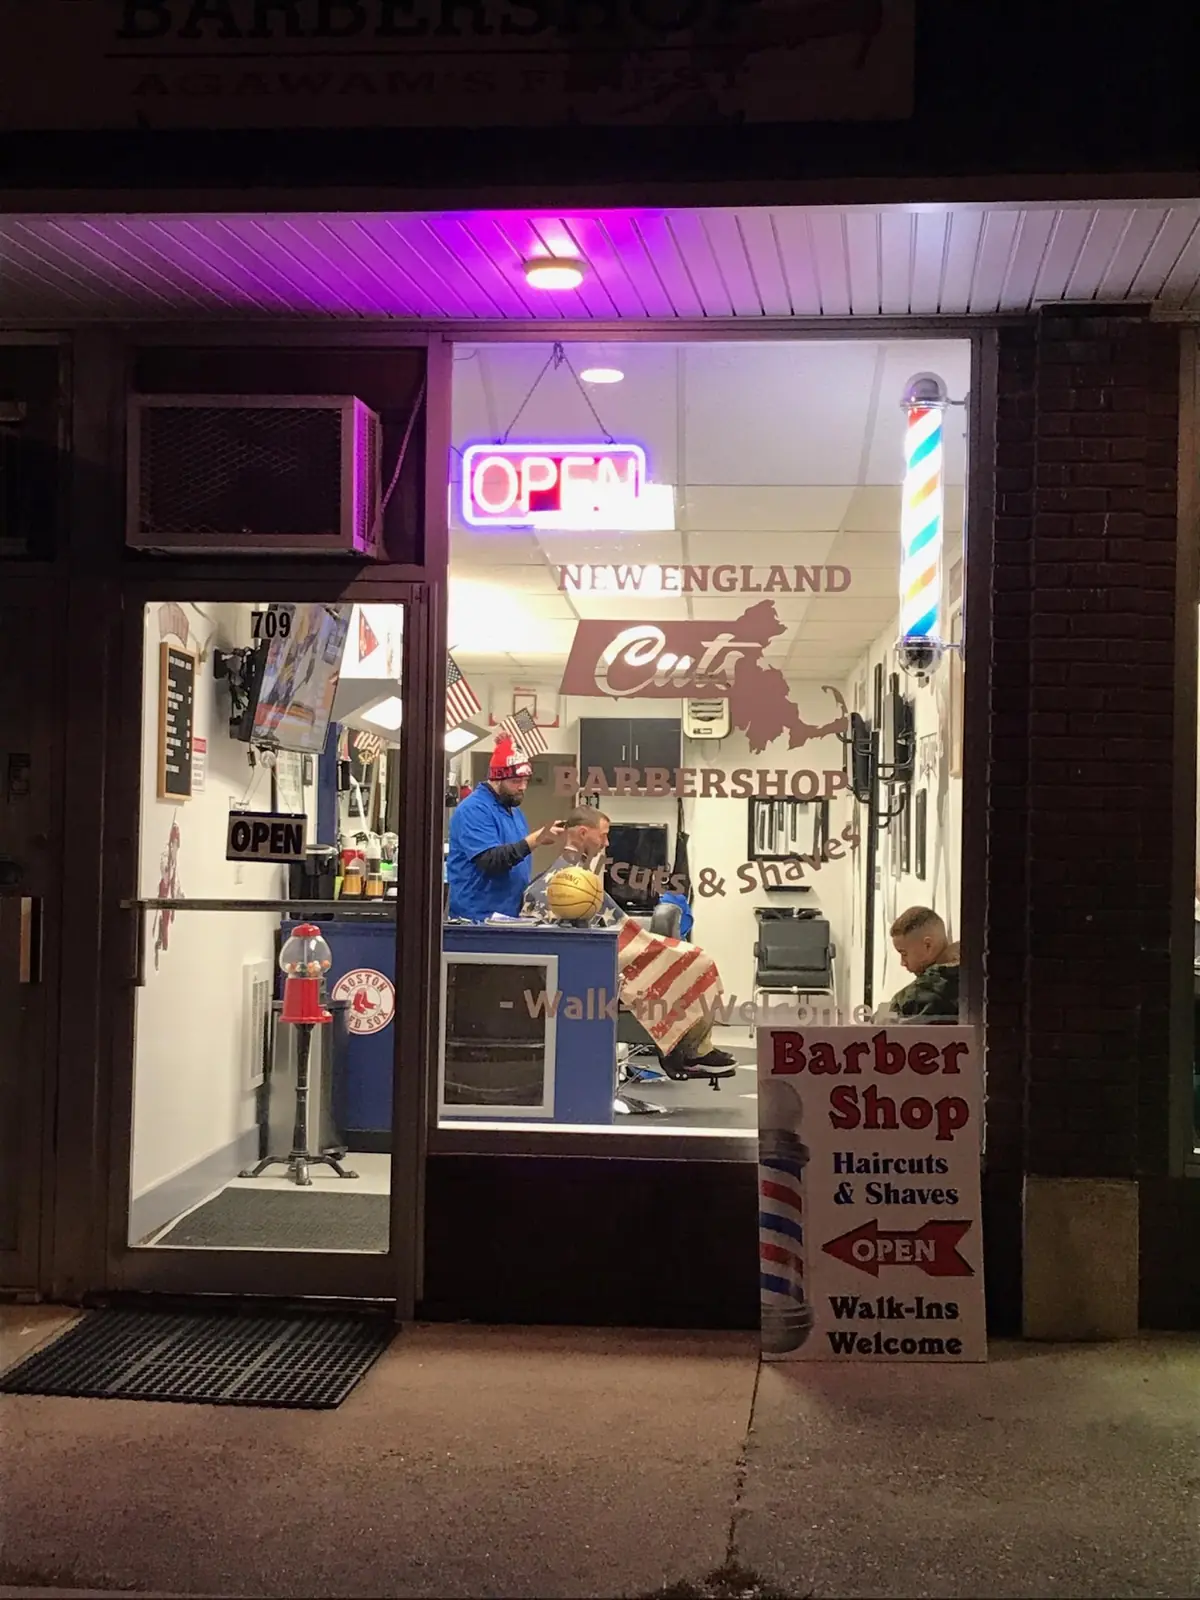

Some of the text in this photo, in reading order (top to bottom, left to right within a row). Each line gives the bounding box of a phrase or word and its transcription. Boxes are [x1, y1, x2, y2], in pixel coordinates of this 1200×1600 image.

[131, 68, 745, 95] AGAWAM'S FEST
[473, 456, 638, 515] OPEN
[557, 564, 852, 593] NEW ENGLAND
[251, 611, 291, 638] 709
[594, 625, 762, 696] Cuts
[552, 766, 849, 800] BARBERSHOP
[231, 820, 303, 855] OPEN
[698, 867, 726, 898] &
[736, 823, 862, 894] Shaves
[341, 974, 388, 994] BOSTON
[366, 1009, 388, 1029] SOX
[523, 988, 687, 1022] Walk-ins
[770, 1030, 970, 1075] Barber
[828, 1084, 970, 1141] Shop
[832, 1152, 949, 1174] Haircuts
[833, 1182, 959, 1205] & Shaves
[851, 1238, 936, 1263] OPEN
[828, 1296, 959, 1320] Walk-Ins
[826, 1331, 962, 1354] Welcome
